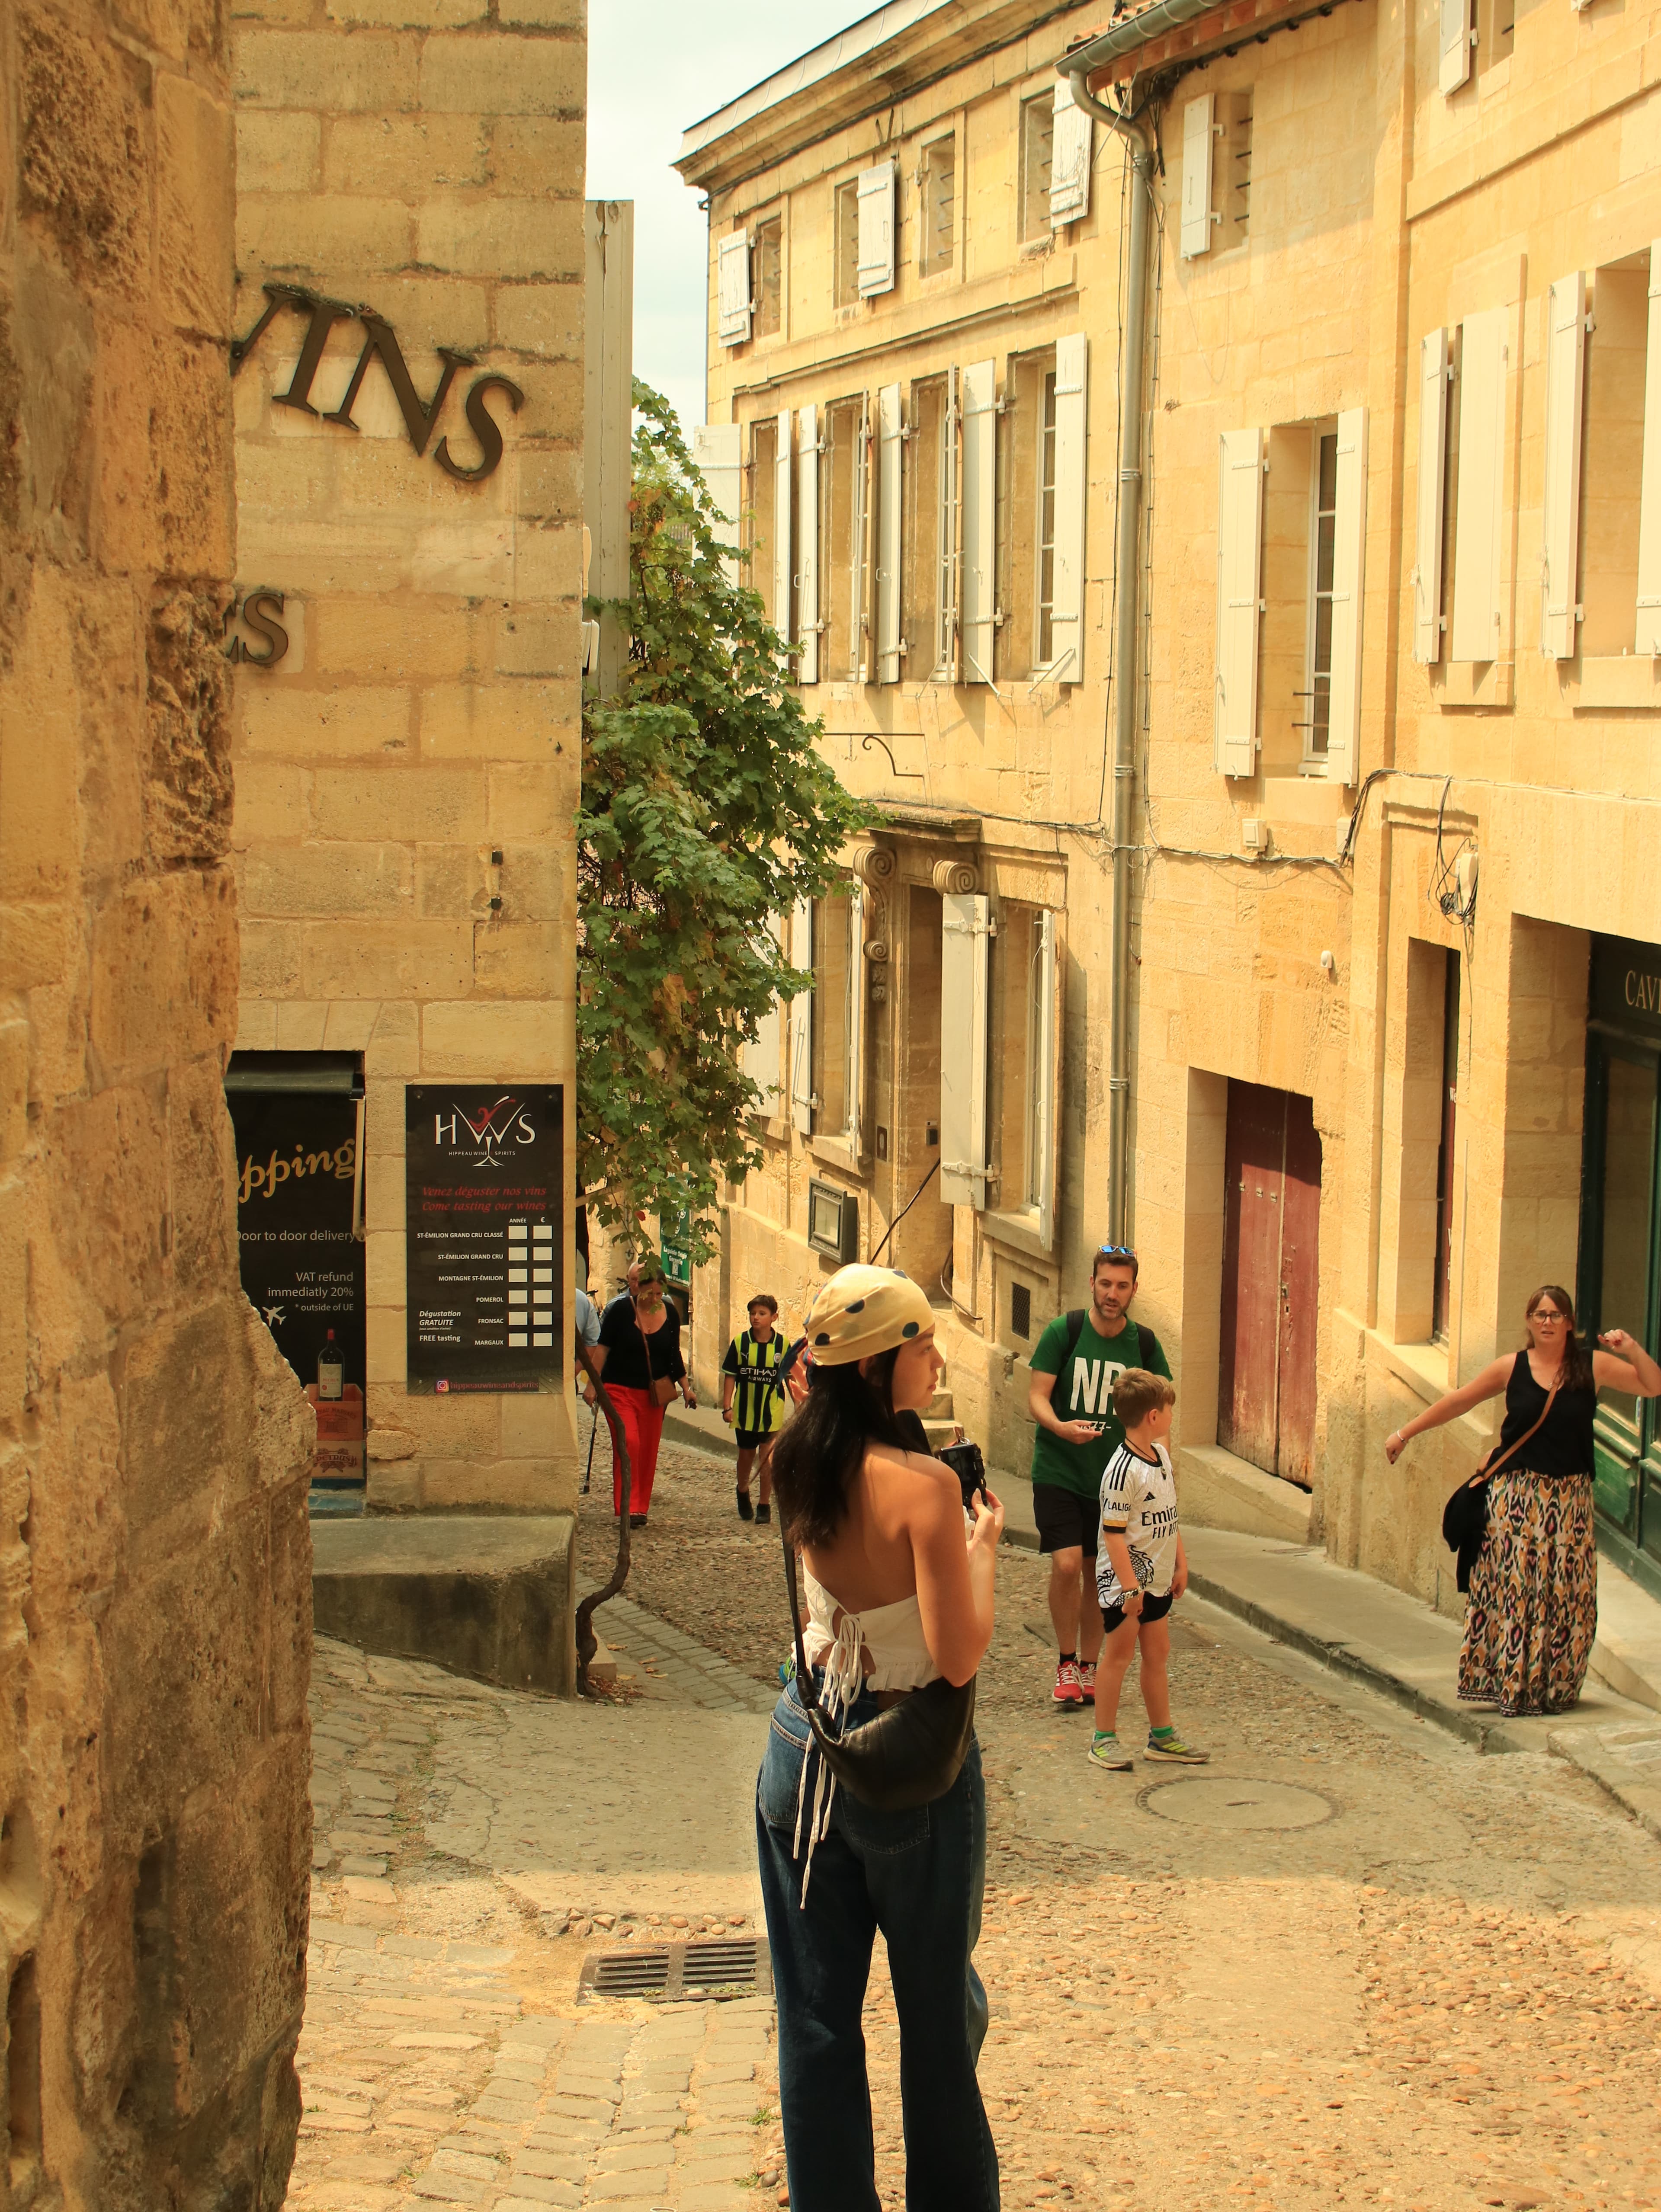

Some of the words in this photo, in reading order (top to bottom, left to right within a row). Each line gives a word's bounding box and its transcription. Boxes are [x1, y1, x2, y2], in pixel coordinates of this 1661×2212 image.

[435, 1103, 536, 1145] HWS
[423, 1187, 452, 1196] Venez
[455, 1186, 500, 1198] déguster
[525, 1186, 546, 1196] vins
[422, 1201, 450, 1211] Come
[454, 1201, 492, 1213] tasting
[516, 1201, 546, 1210] wines
[264, 1231, 276, 1241] to
[279, 1230, 307, 1241] door
[310, 1230, 354, 1243] delivery
[296, 1272, 316, 1281] VAT
[319, 1272, 353, 1281] refund
[268, 1287, 328, 1299] immediatly
[330, 1287, 354, 1296] 20%
[740, 1368, 777, 1376] ETIHAD
[1152, 1525, 1167, 1539] FLY
